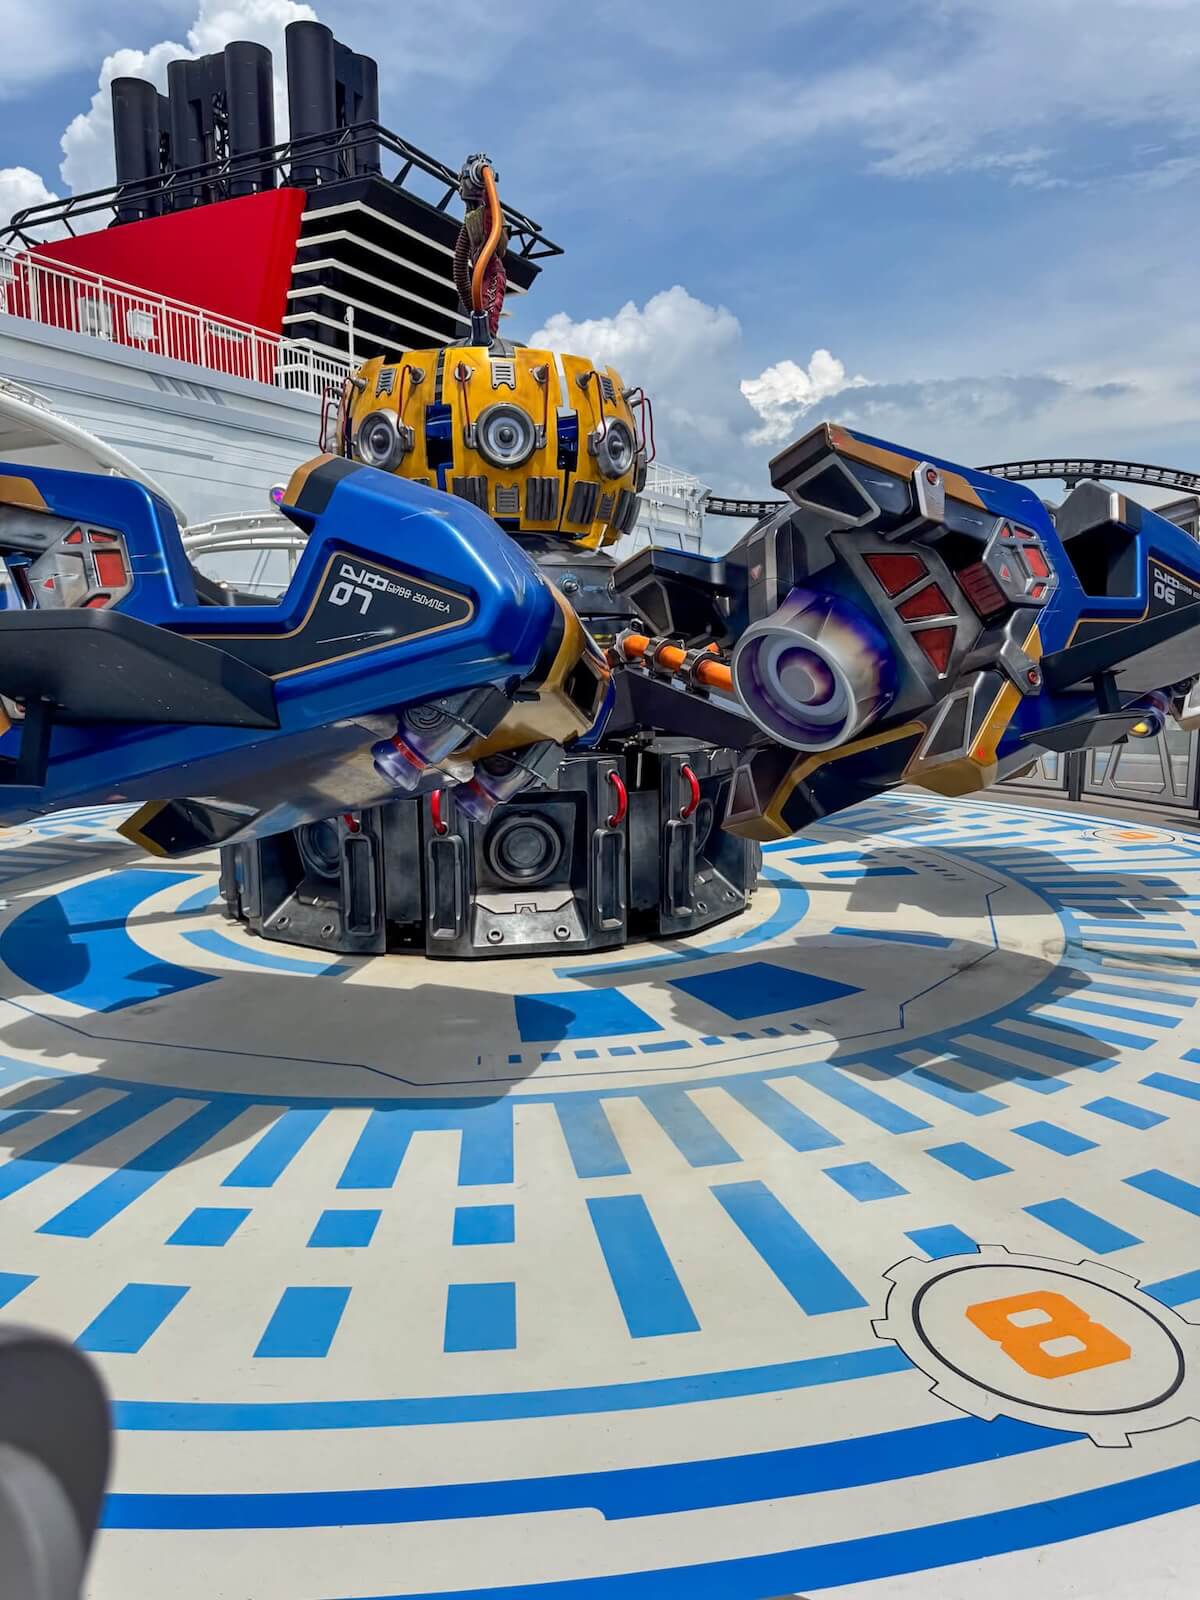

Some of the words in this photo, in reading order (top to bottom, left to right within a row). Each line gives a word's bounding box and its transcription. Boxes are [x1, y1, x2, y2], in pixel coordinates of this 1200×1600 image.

[328, 581, 373, 615] 07
[1154, 581, 1176, 606] 06
[965, 1290, 1132, 1380] 8
